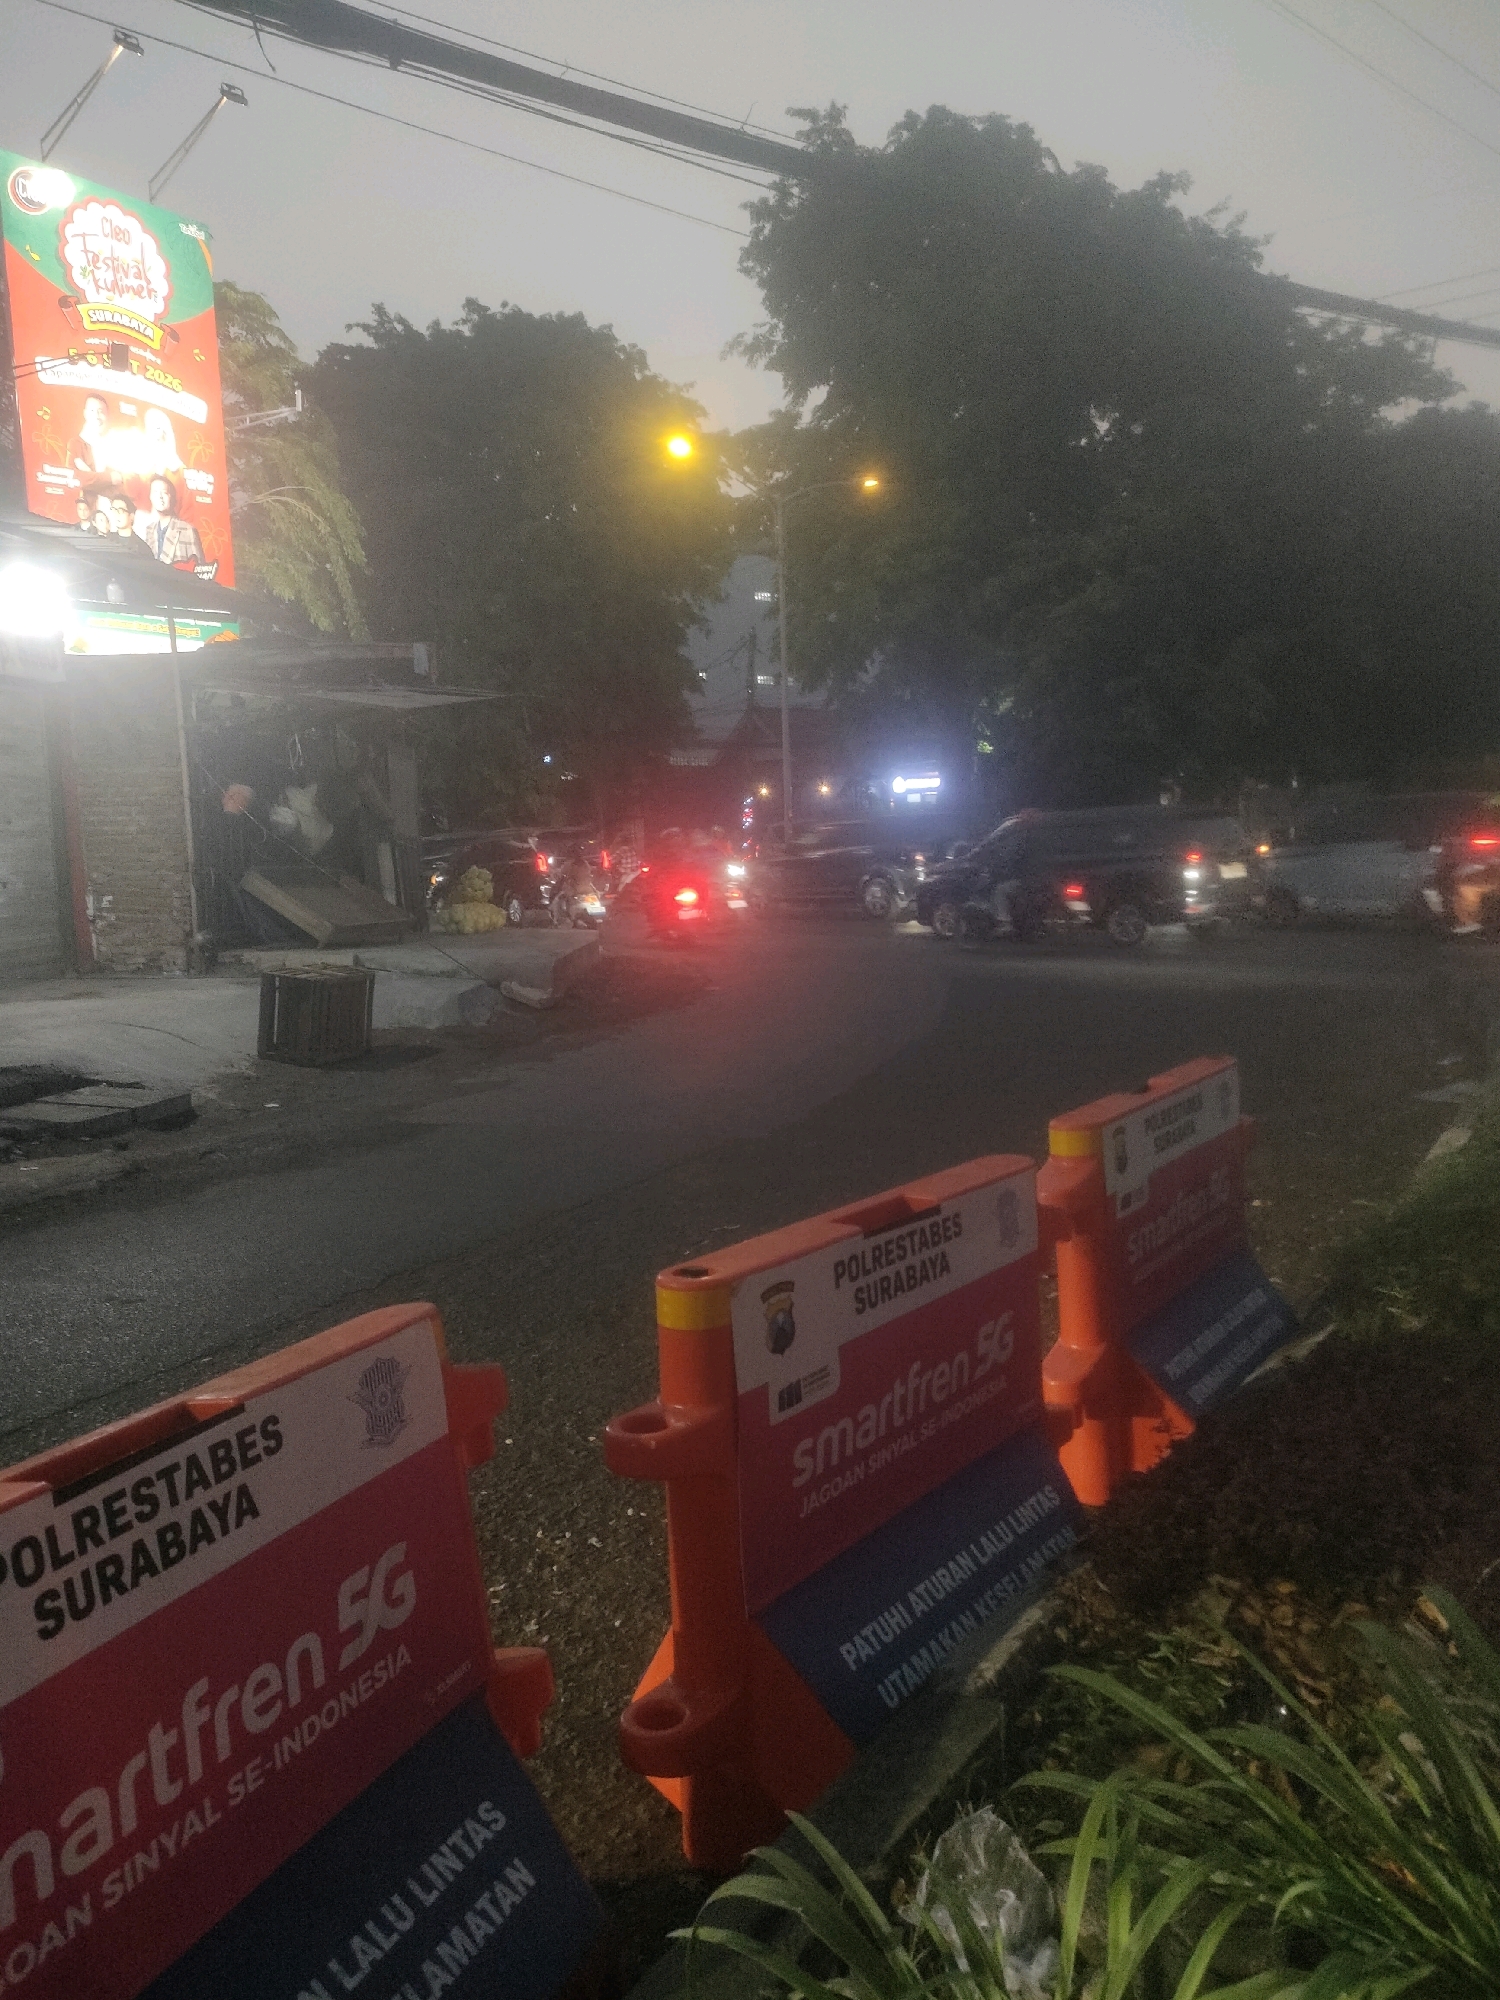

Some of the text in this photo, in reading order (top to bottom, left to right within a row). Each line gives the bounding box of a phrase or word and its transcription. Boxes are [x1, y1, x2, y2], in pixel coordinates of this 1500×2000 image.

[71, 232, 152, 286] Festival
[101, 216, 131, 246] Cleo
[87, 308, 155, 343] SURABAYA
[144, 364, 183, 393] 2026
[834, 1212, 963, 1289] POLRESTABES
[854, 1251, 950, 1316] SURABAYA
[792, 1310, 1015, 1488] smartfren 5G
[0, 1414, 283, 1587] OLRESTABES
[799, 1462, 865, 1519] JAGOAN
[868, 1433, 918, 1475] SINYAL
[34, 1483, 260, 1641] SURABAYA
[337, 1541, 417, 1672] 5G
[839, 1483, 1061, 1671] PATUHI ATURAN LALU LINTAS
[877, 1525, 1079, 1709] UTAMAKAN KESELAMATAN
[0, 1643, 413, 1996] OAN SINYAL SE-INDONESIA
[327, 1800, 507, 1992] LALU LINTAS
